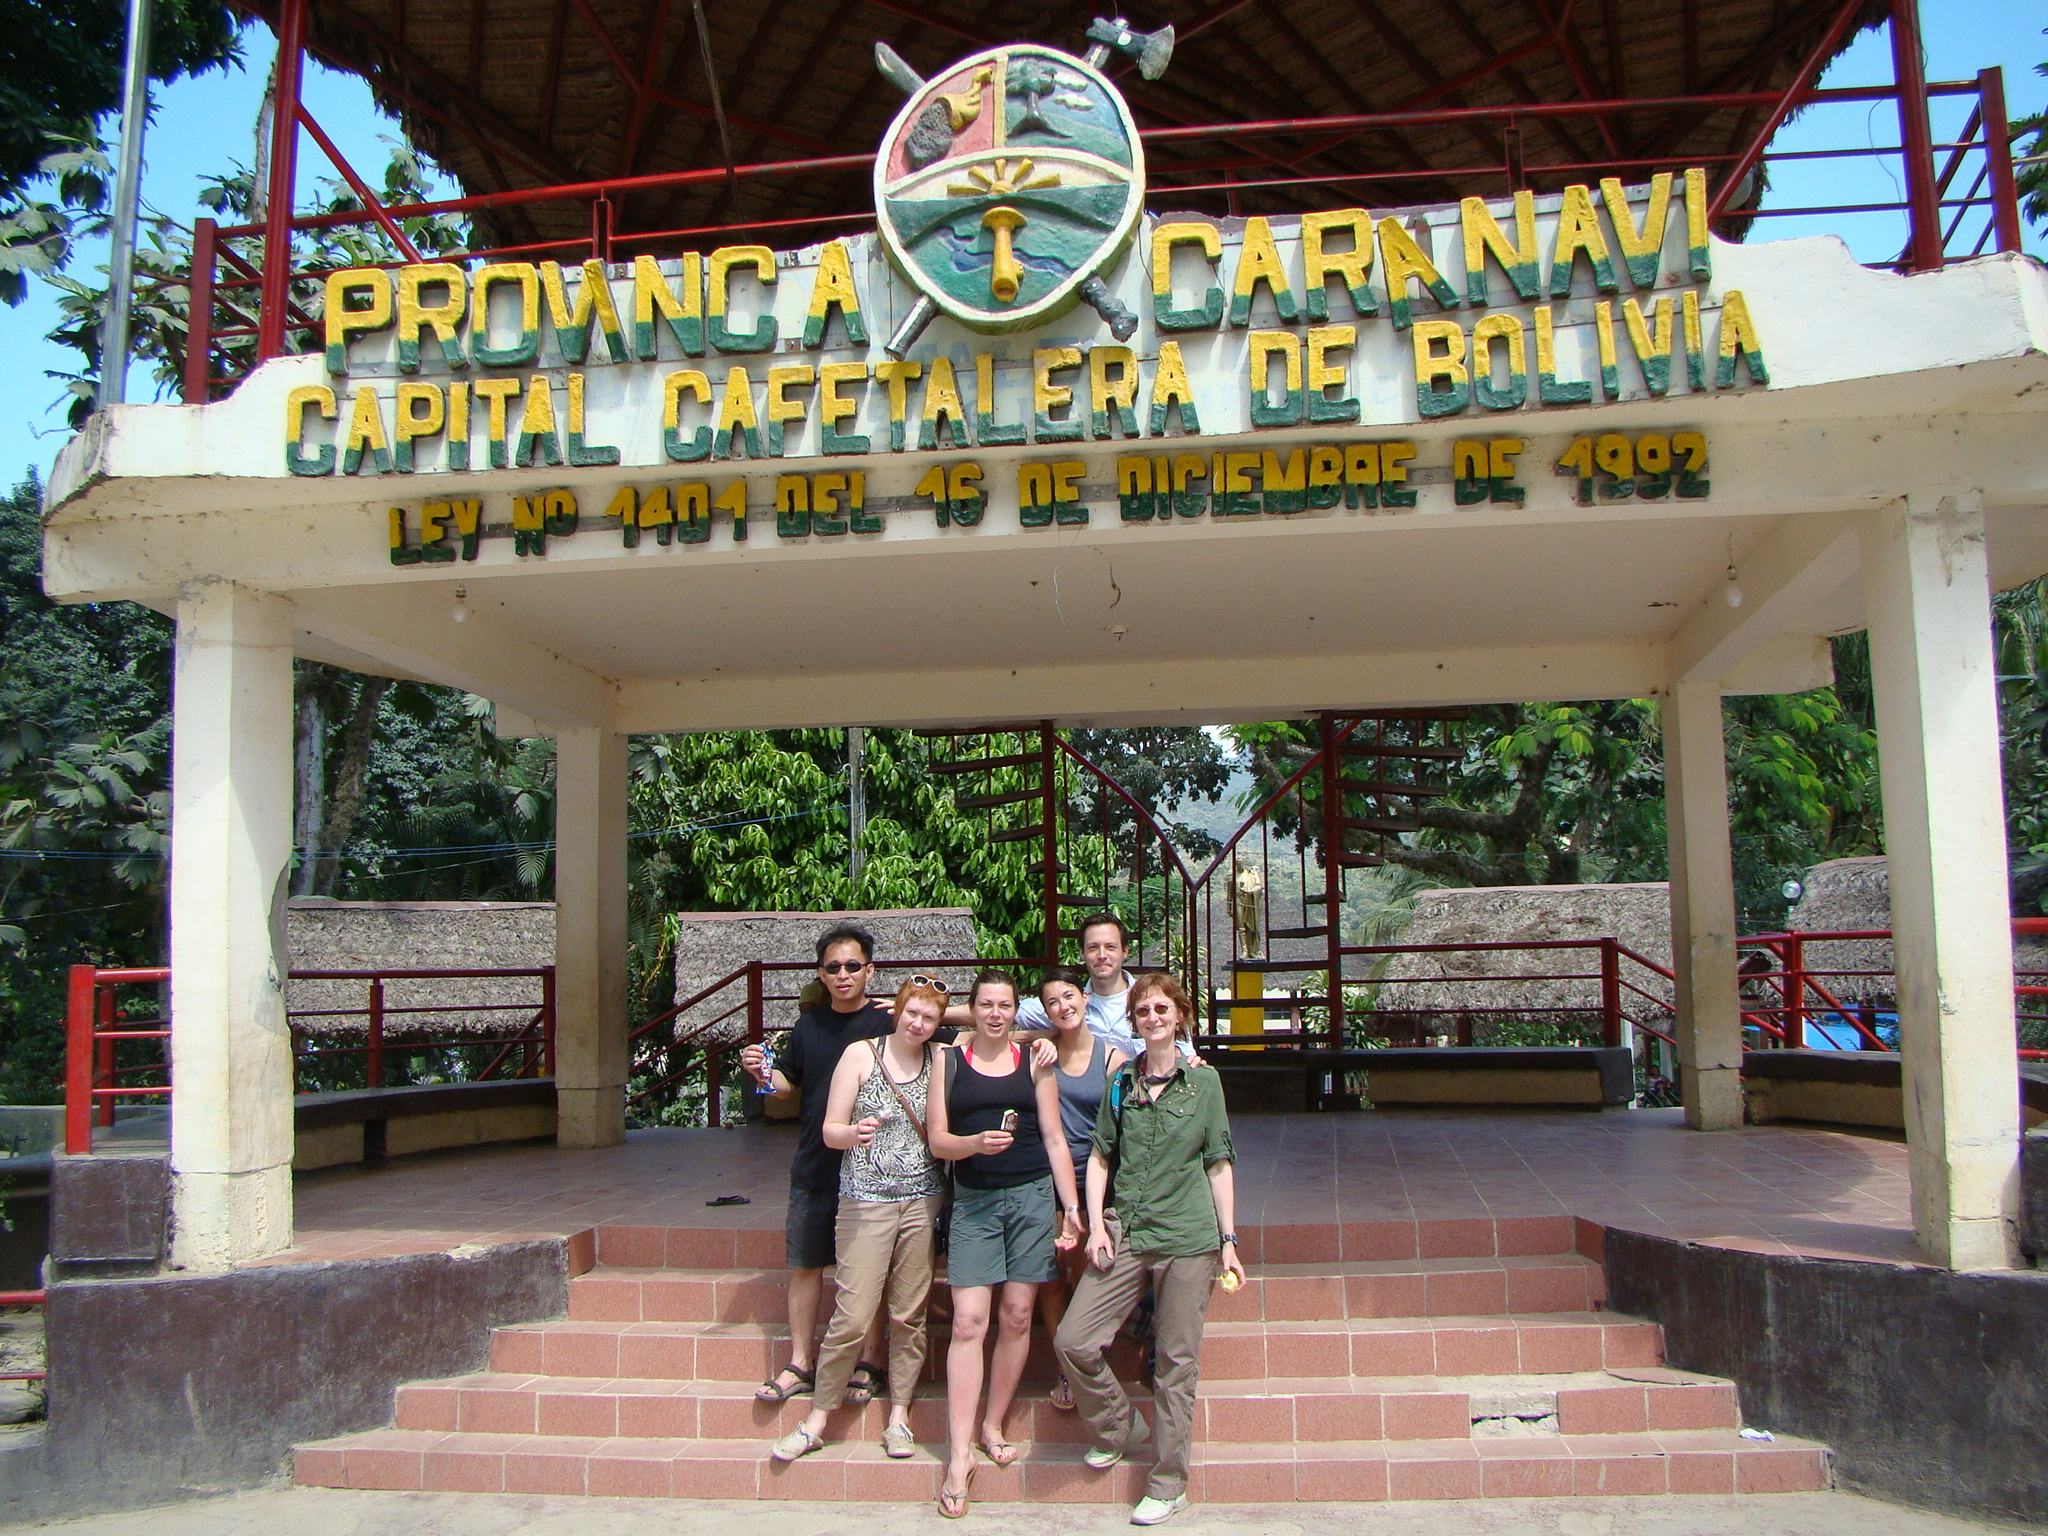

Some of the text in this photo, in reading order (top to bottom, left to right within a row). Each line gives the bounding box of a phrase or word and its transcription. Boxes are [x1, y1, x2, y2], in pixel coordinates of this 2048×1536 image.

[1152, 168, 1712, 332] CARANAVI
[286, 290, 1770, 477] CAPITAL CAFETALERA DE BOLIVIA
[389, 499, 484, 566] LEY
[604, 481, 748, 548] 1401
[776, 472, 885, 538] DEL
[913, 461, 984, 529] 16
[1017, 460, 1090, 527] DE
[1117, 442, 1418, 522] DICIEMBRE
[1453, 438, 1525, 507] DE
[1558, 432, 1711, 507] 1992
